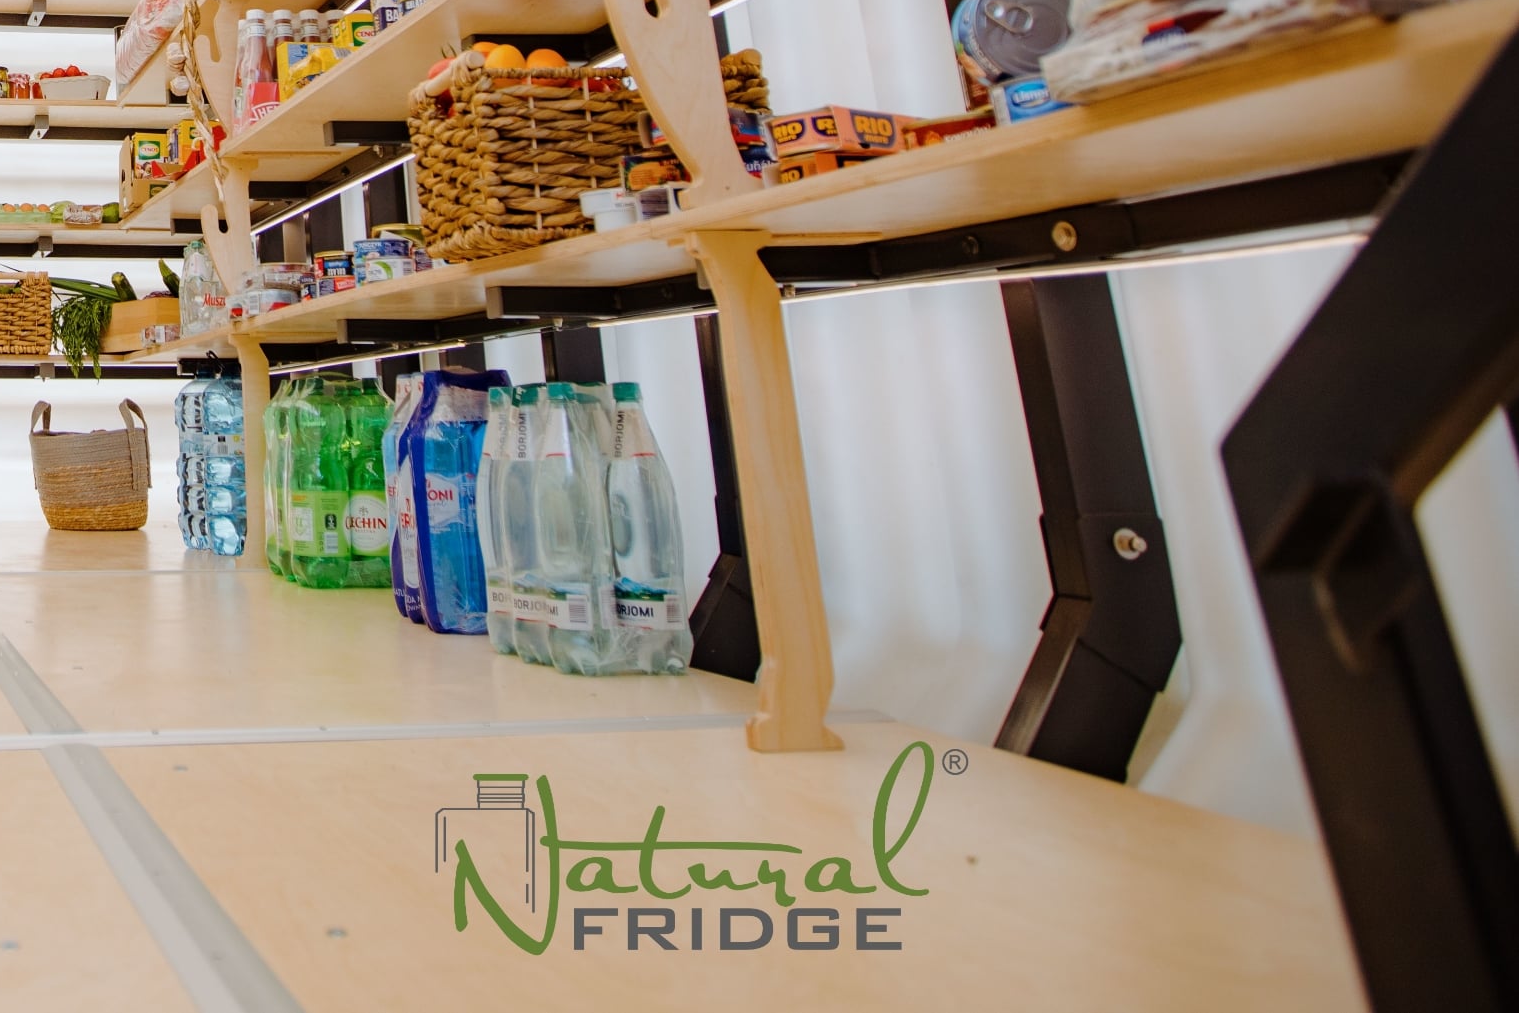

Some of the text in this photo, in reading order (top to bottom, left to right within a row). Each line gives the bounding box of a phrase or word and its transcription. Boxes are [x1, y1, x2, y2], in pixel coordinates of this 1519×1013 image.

[773, 121, 803, 139] RIO
[853, 115, 893, 137] RIO
[517, 413, 527, 459] BORJOMI
[615, 411, 625, 458] BORJOMI
[428, 489, 454, 501] ONI
[345, 516, 387, 530] CECHIN
[616, 603, 654, 618] ORJOMI
